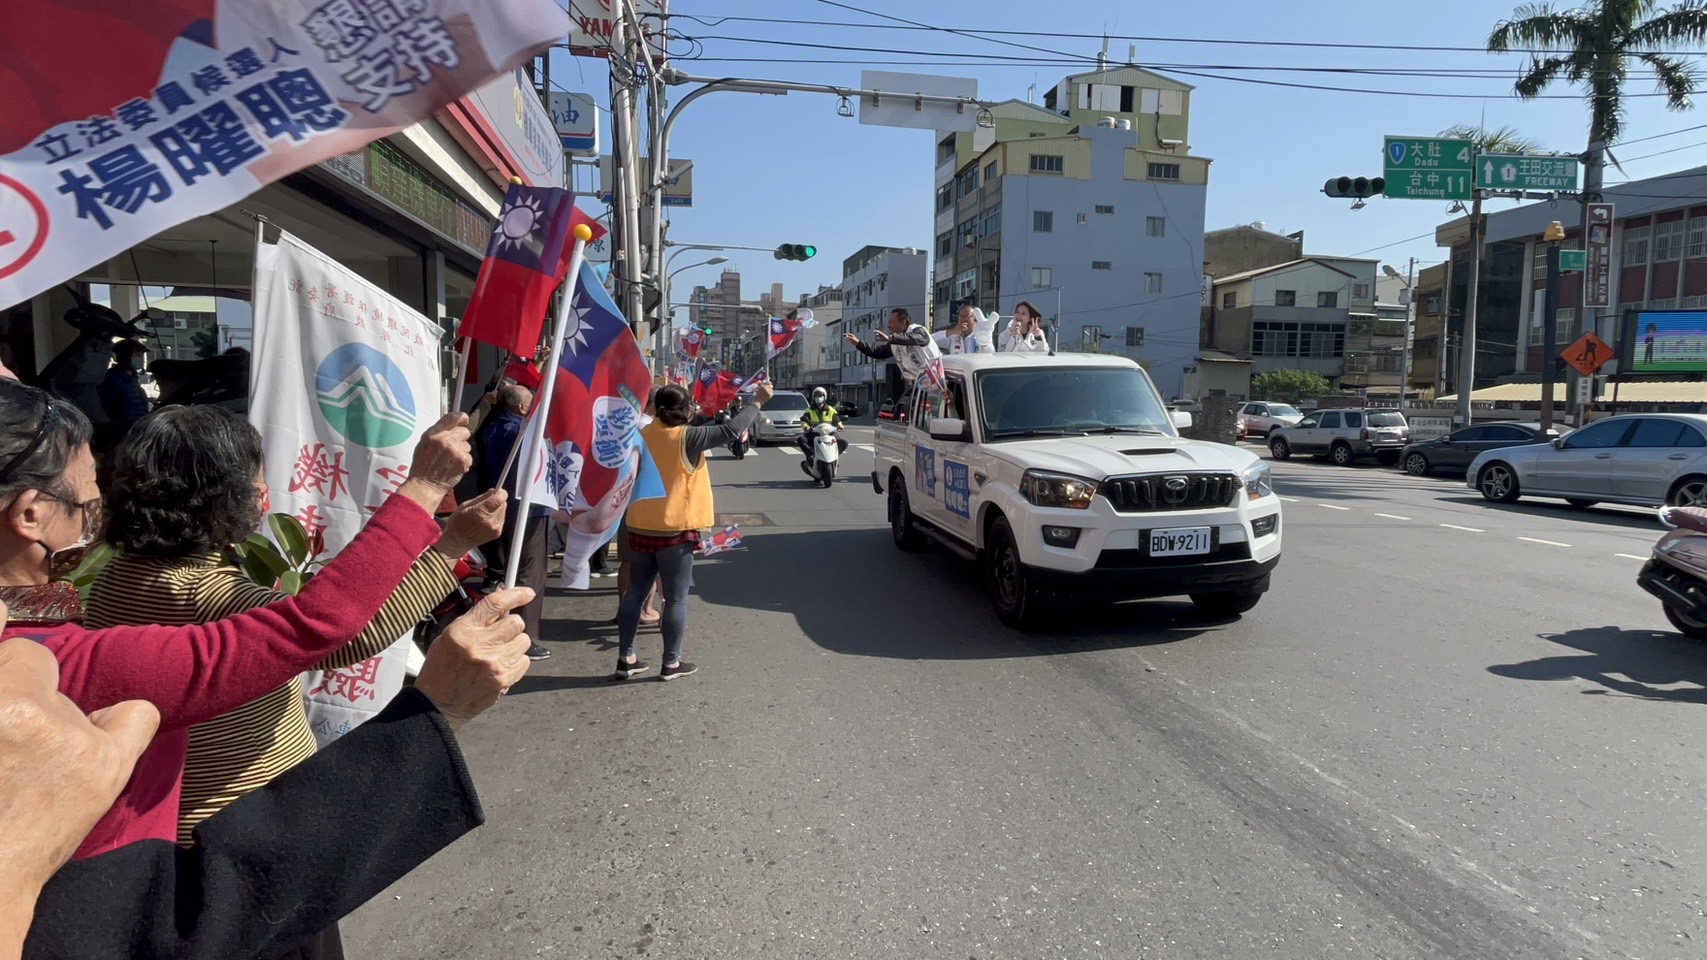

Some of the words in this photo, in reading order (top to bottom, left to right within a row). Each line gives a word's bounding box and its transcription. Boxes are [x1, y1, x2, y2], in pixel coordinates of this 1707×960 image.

[340, 15, 460, 113] 支持
[35, 36, 299, 164] 立法委員候選人
[551, 97, 580, 125] 油
[57, 66, 350, 230] 楊曜聰
[1411, 142, 1441, 158] 大肚
[1457, 147, 1470, 164] 4
[1414, 157, 1439, 167] Dadu
[1519, 160, 1576, 178] 王田交流道
[1409, 171, 1440, 187] 台中
[1447, 176, 1465, 194] 11
[1525, 176, 1569, 187] FREEWAY
[1405, 185, 1445, 198] Taichung
[1151, 533, 1207, 552] BDW-9211
